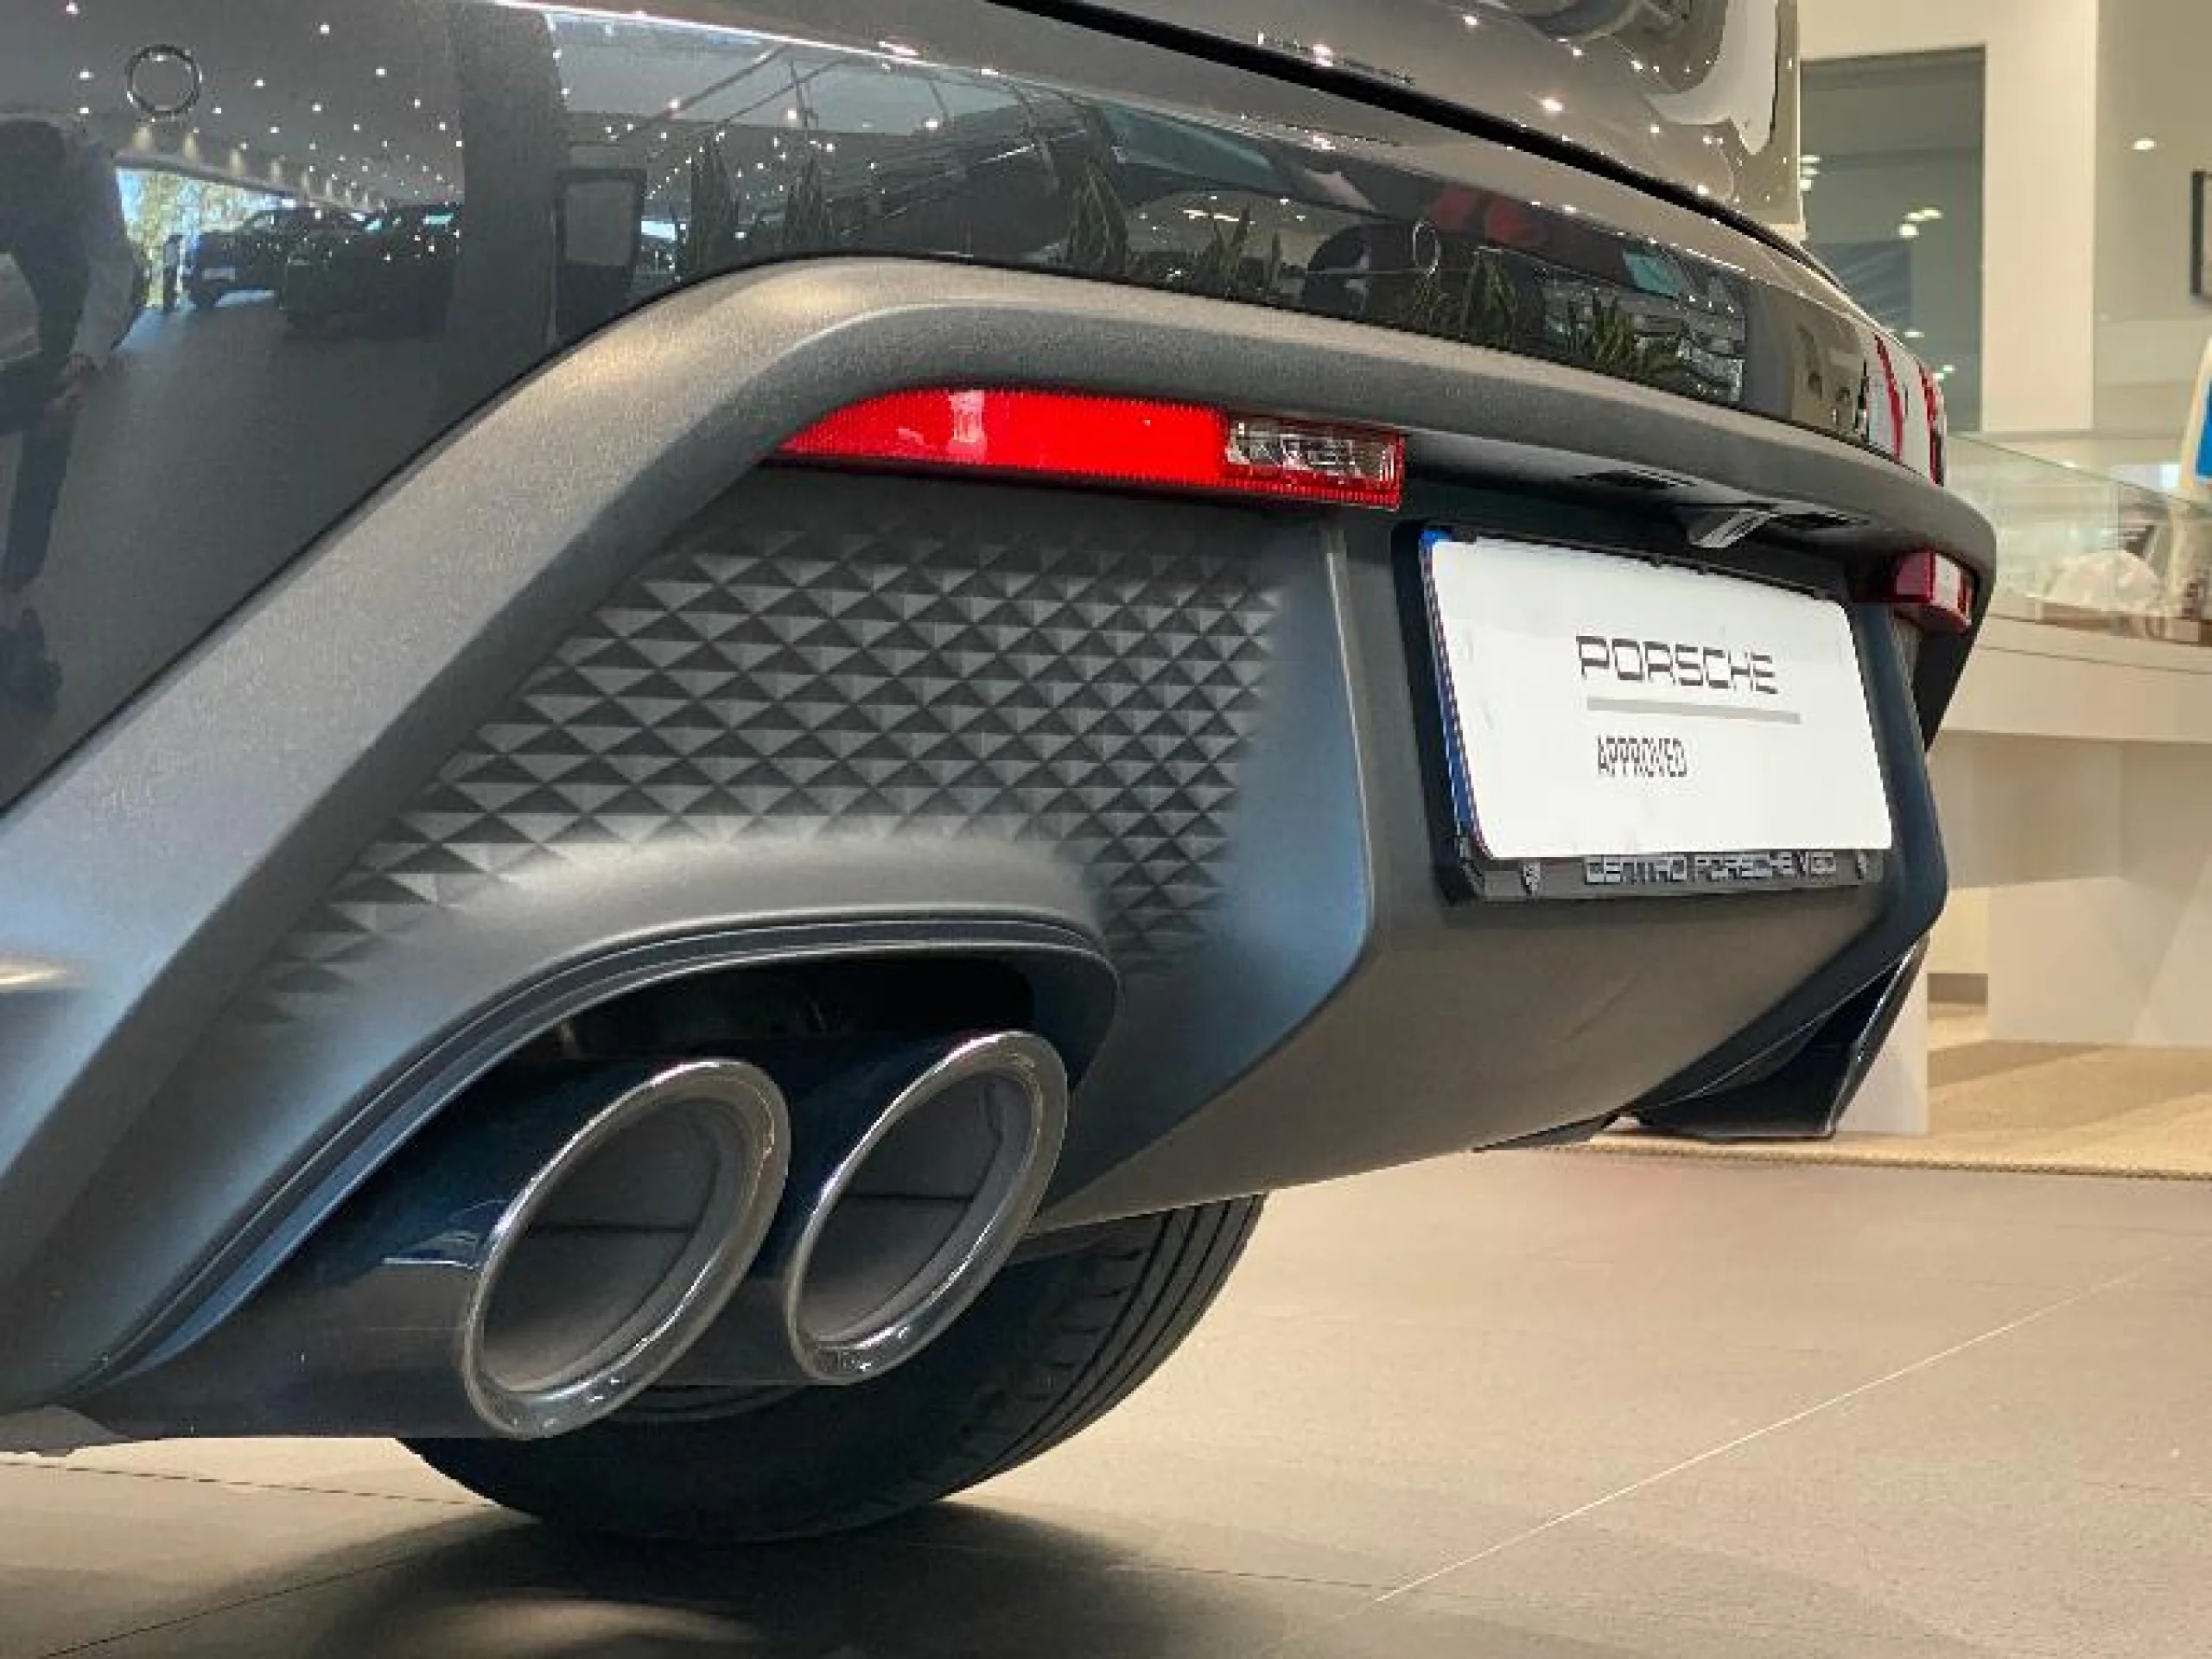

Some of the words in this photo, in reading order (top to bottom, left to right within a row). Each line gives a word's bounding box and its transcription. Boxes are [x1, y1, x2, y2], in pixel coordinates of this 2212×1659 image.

[1576, 635, 1778, 694] PORSCHE
[1598, 734, 1688, 778] APPROVED
[1586, 855, 1688, 885] CENTRO
[1694, 850, 1794, 882] PORSCHE
